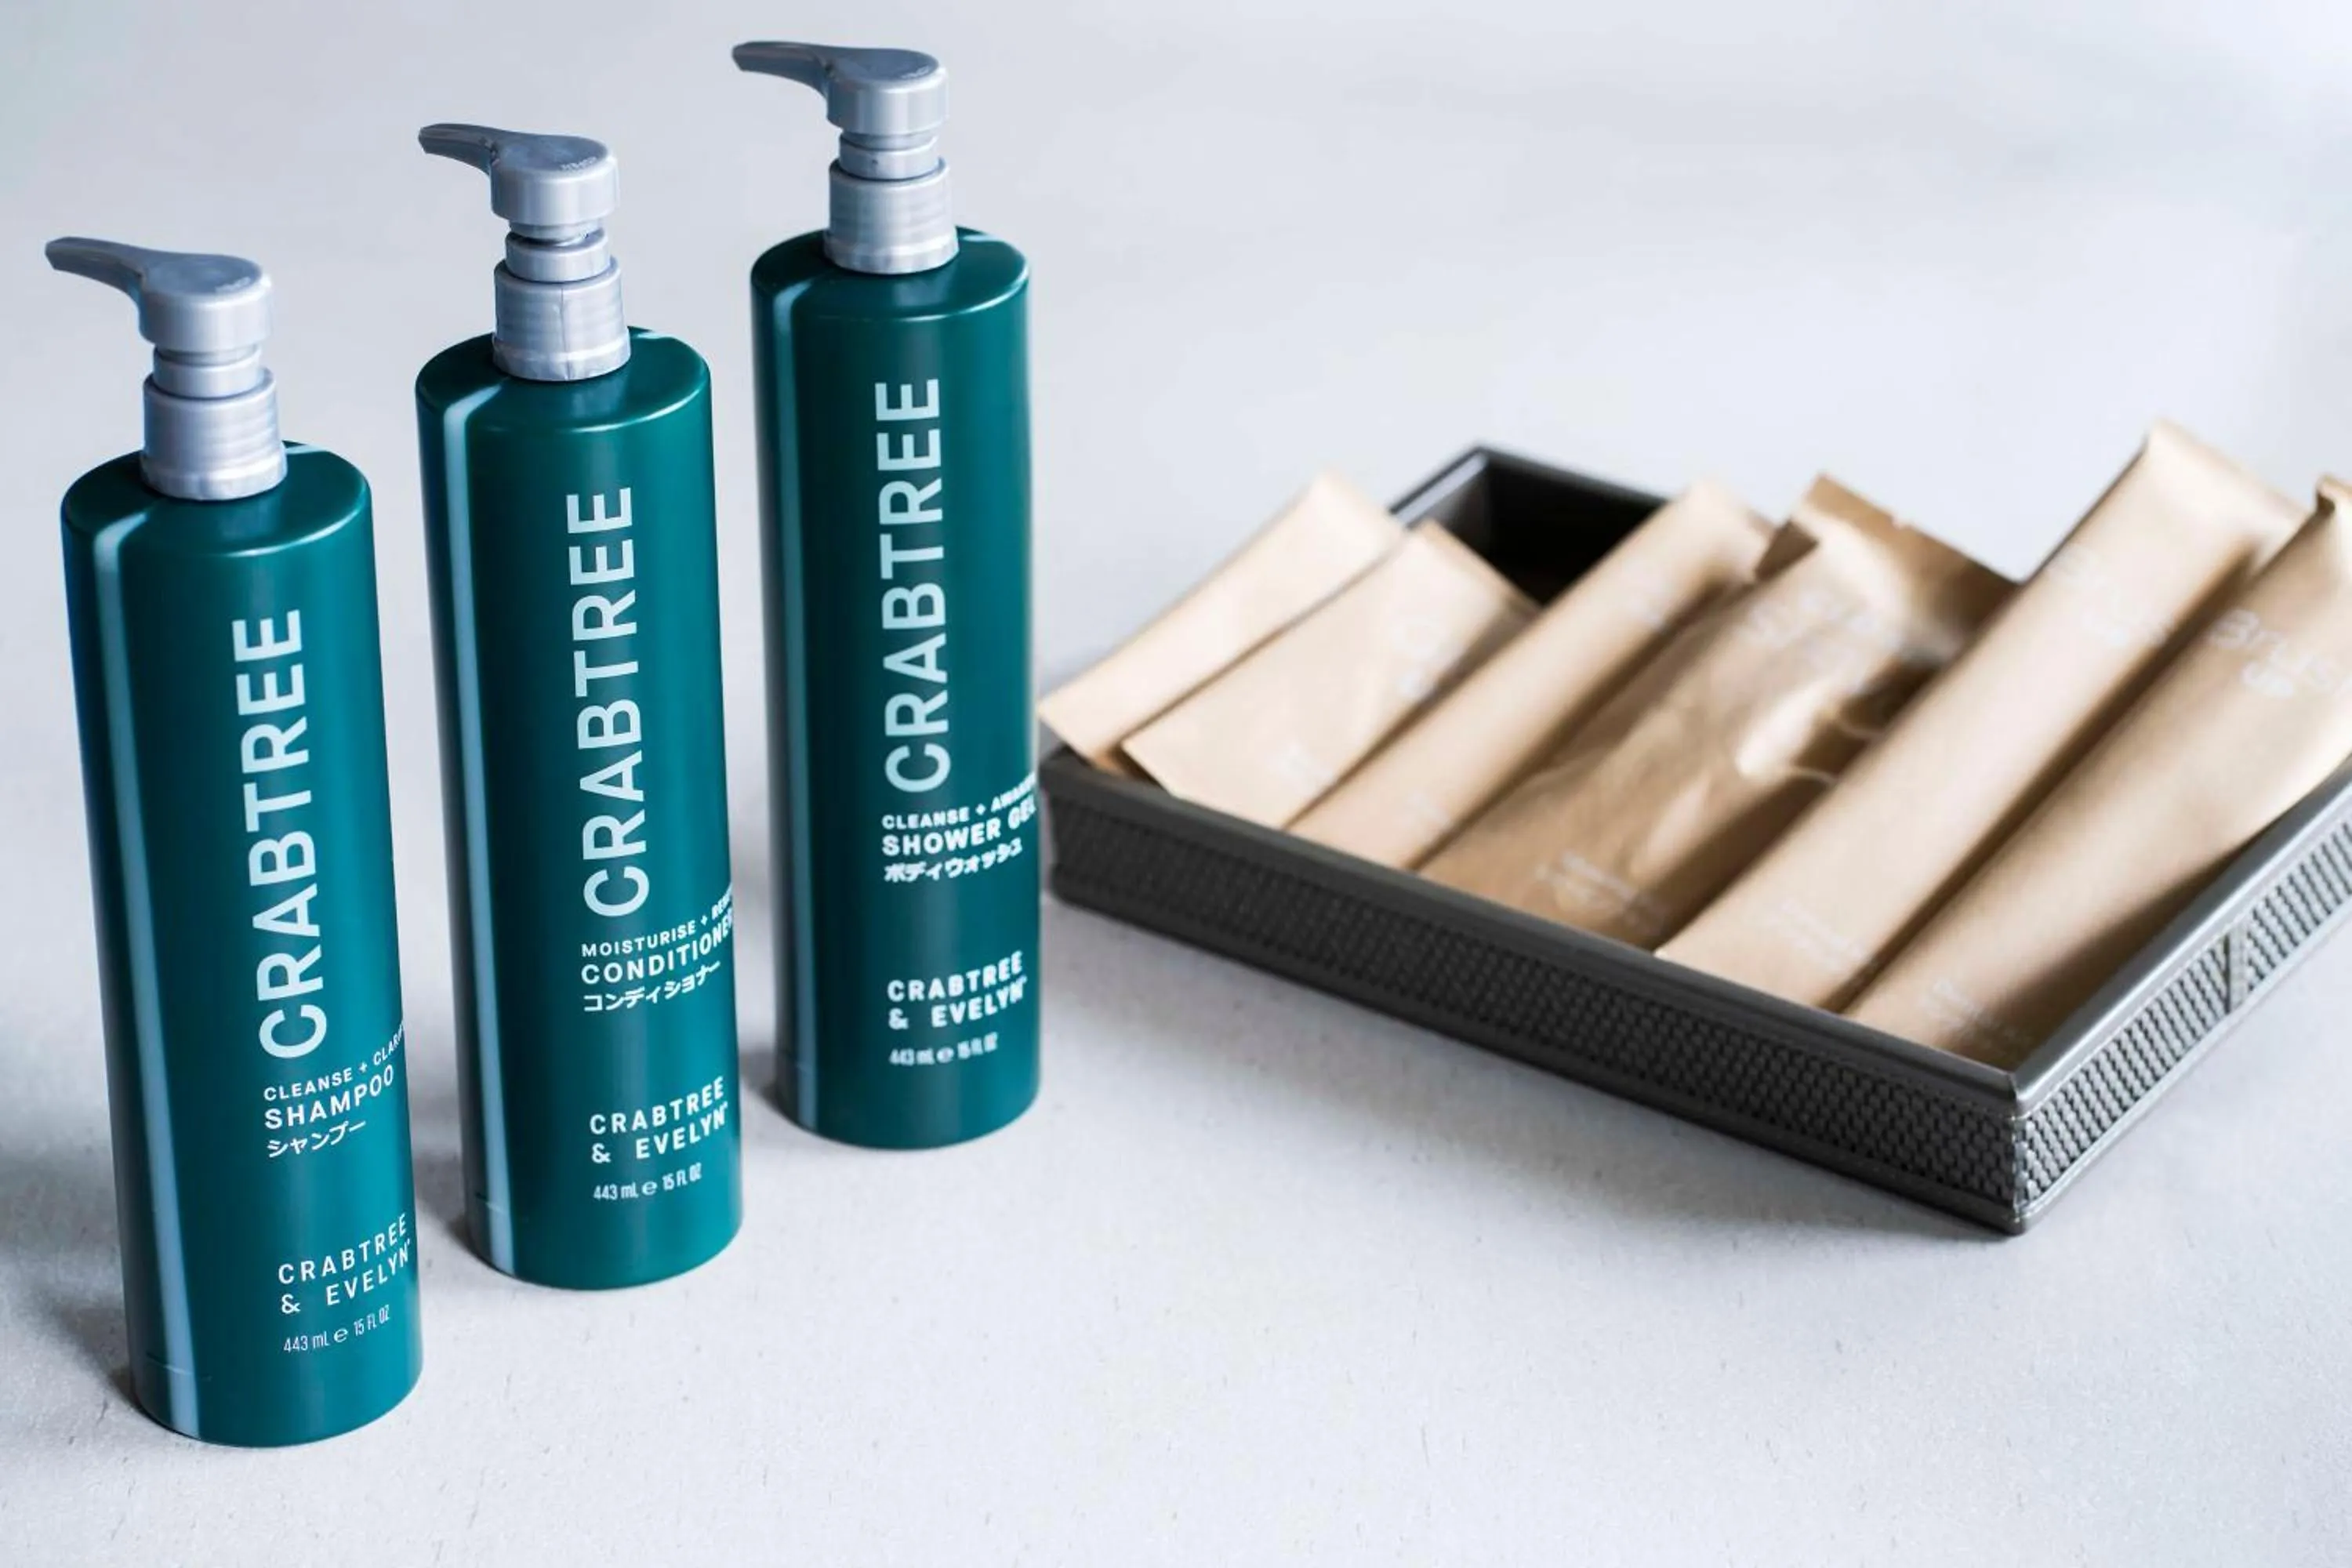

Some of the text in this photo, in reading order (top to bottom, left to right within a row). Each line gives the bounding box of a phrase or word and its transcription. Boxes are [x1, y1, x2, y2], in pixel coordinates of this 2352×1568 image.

[874, 379, 951, 792] CRABTREE
[566, 487, 650, 916] CRABTREE
[232, 609, 328, 1059] CRABTREE
[882, 806, 970, 830] CLEANSE
[882, 817, 1001, 856] SHOWER
[582, 920, 696, 957] MOISTURISE
[887, 950, 1023, 1002] CRABTREE
[888, 1007, 909, 1030] &
[263, 1067, 354, 1102] CLEANSE
[264, 1064, 394, 1129] SHAMPOO
[590, 1076, 724, 1134] CRABTREE
[267, 1120, 367, 1158] シャンプー
[591, 1104, 726, 1163] & EVELYN
[593, 1183, 618, 1200] 443
[278, 1213, 407, 1285] CRABTREE
[281, 1240, 409, 1314] & EVELYN
[283, 1334, 308, 1353] 443
[312, 1330, 330, 1349] mL
[354, 1318, 365, 1336] 15
